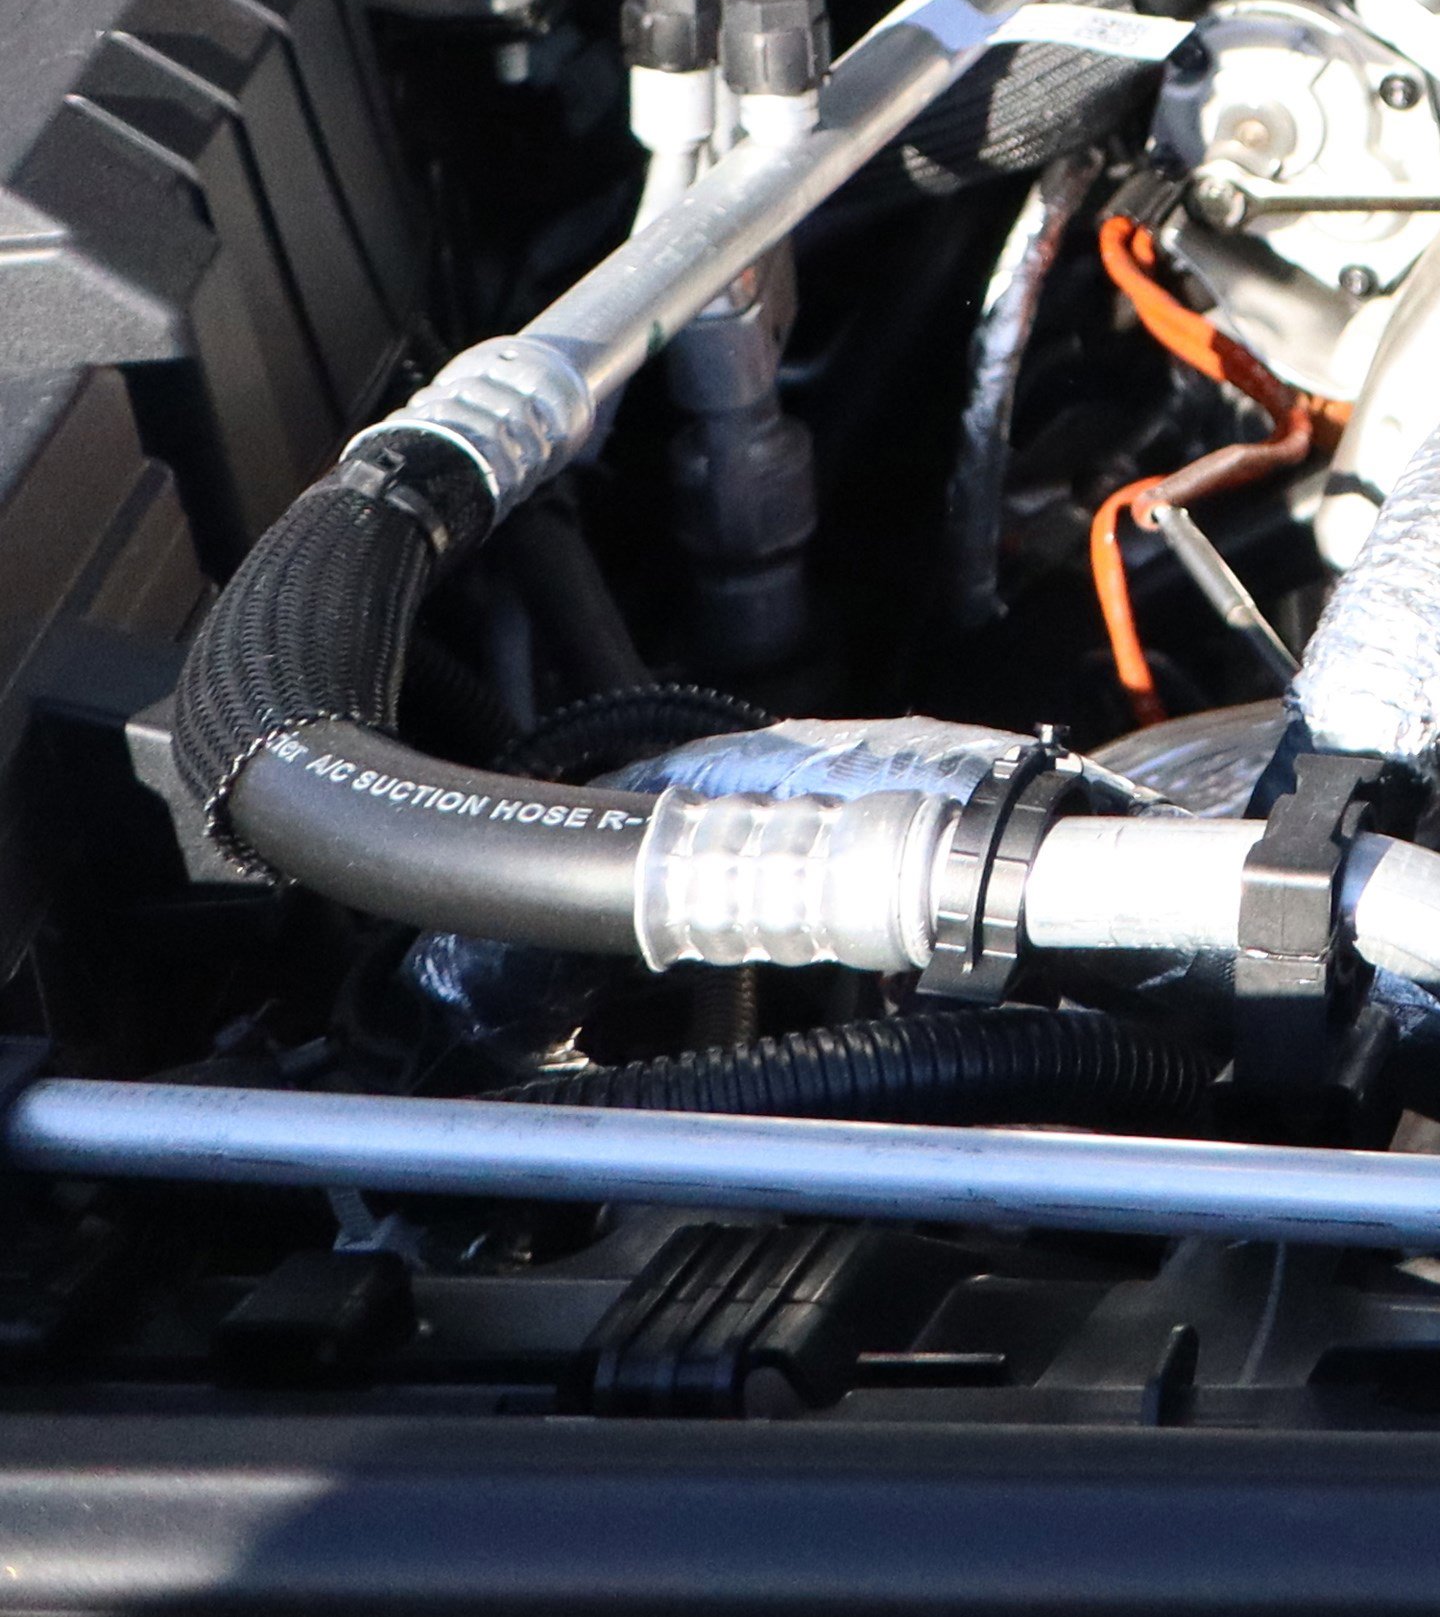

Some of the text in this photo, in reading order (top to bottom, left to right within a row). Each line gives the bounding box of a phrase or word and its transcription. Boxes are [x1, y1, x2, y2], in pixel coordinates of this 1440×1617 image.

[305, 753, 357, 783] A/C
[351, 769, 492, 817] SUCTION
[488, 798, 594, 829] HOSE
